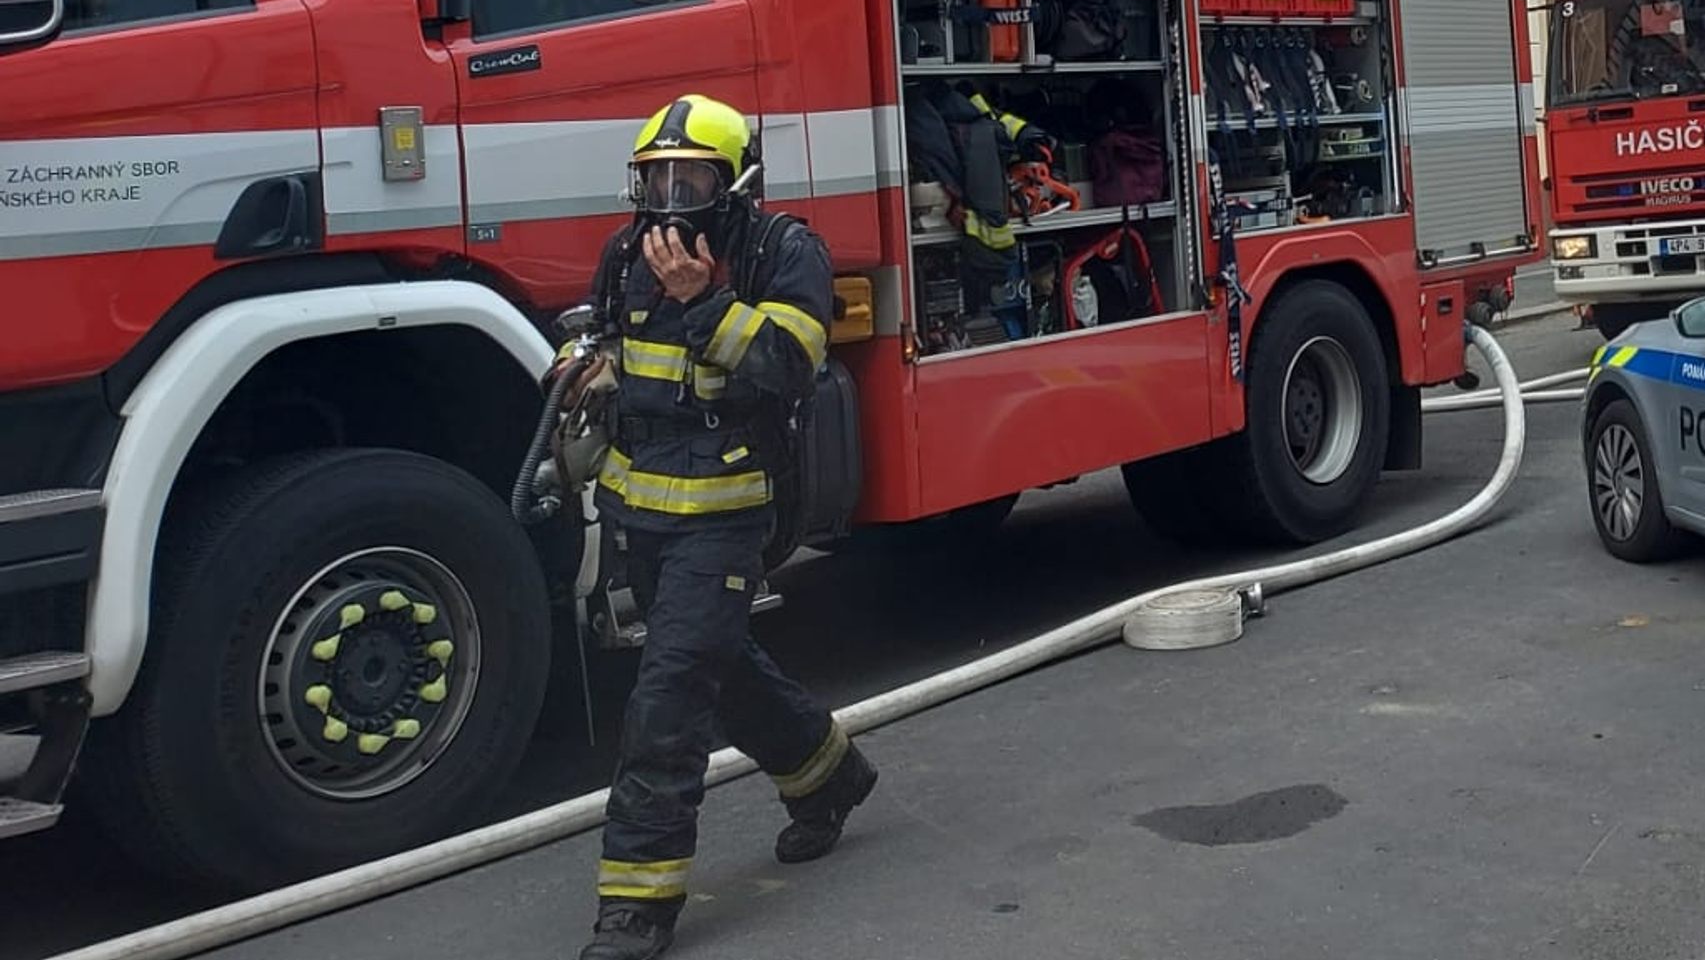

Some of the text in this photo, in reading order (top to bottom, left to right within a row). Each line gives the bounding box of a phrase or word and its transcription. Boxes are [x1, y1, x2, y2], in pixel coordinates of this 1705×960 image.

[996, 10, 1030, 23] WISS
[1562, 1, 1574, 17] 3
[6, 161, 180, 184] ZÁCHRANNÝ SBOR
[81, 186, 141, 203] KRAJE
[1640, 177, 1695, 195] IVECO
